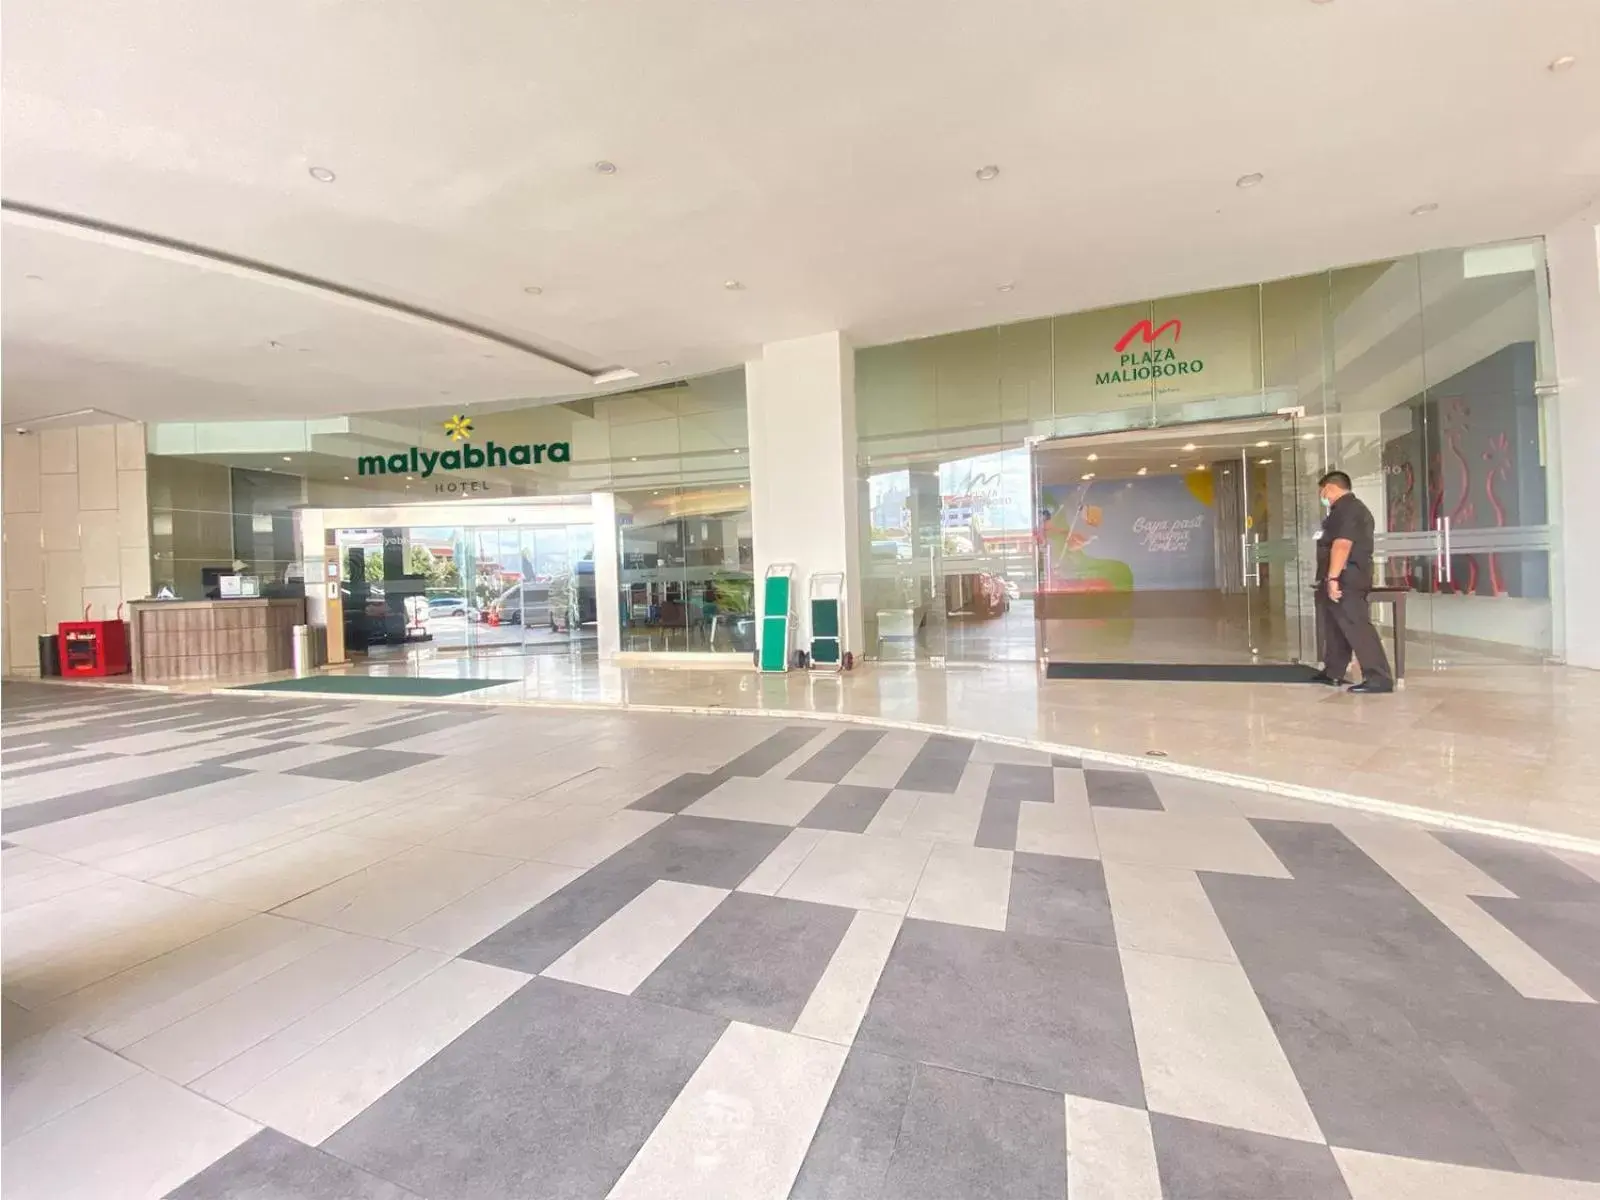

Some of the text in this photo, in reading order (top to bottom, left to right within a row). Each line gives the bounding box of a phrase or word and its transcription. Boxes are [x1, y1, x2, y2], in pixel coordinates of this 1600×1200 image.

[1120, 348, 1175, 367] PLAZA
[1095, 360, 1204, 385] MALIOBORO
[358, 441, 570, 477] malyabhara
[435, 481, 490, 493] HOTEL
